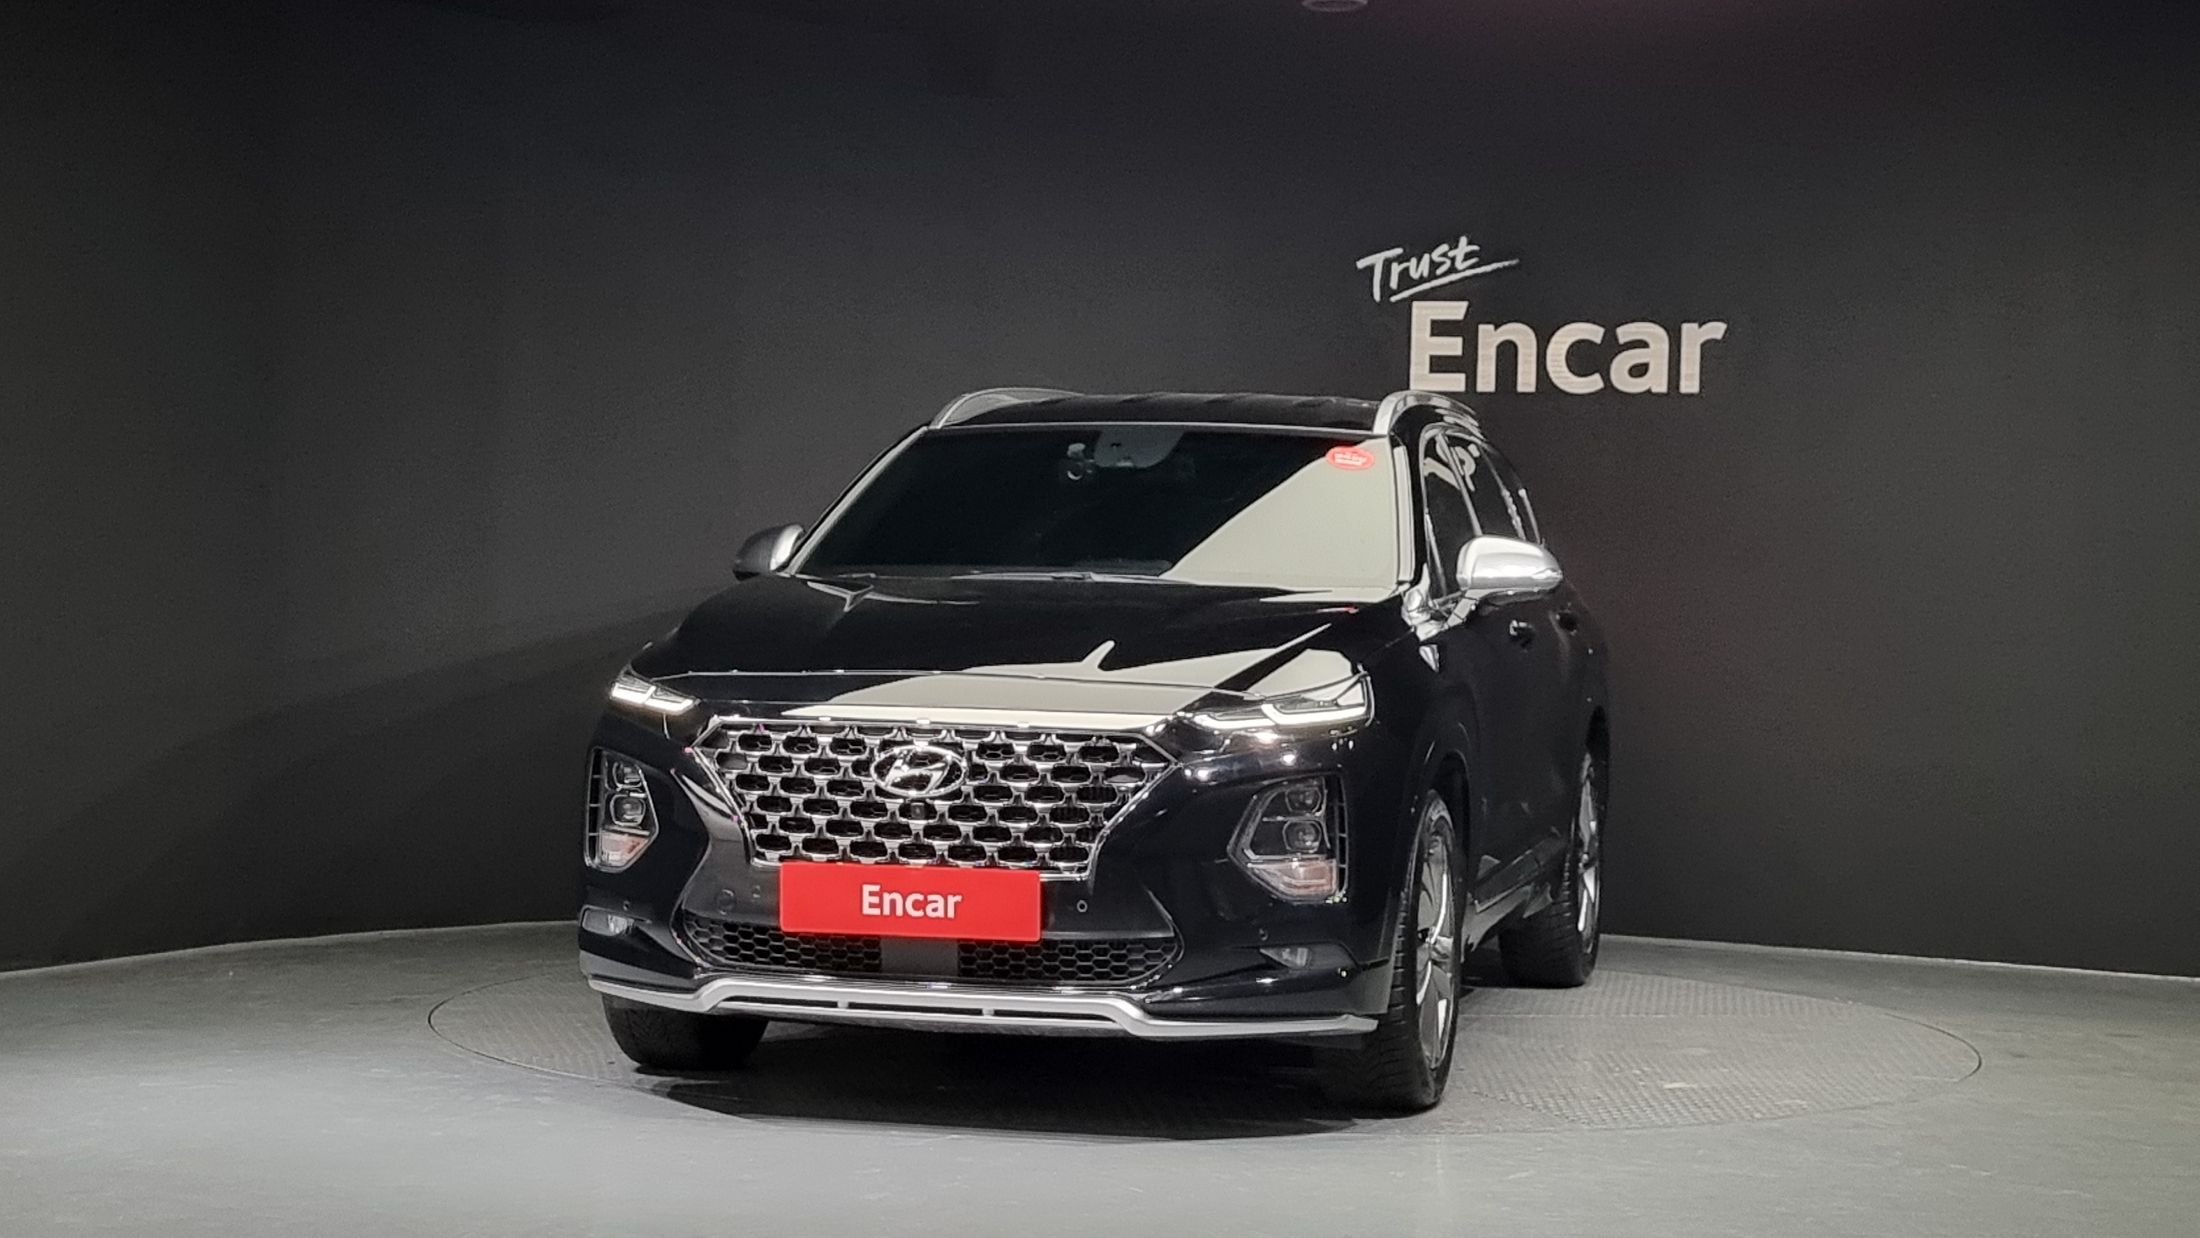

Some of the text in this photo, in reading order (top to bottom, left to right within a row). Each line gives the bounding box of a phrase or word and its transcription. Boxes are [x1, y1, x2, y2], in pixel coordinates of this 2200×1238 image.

[1356, 235, 1480, 303] Trust
[1409, 300, 1728, 395] Encar
[861, 883, 963, 919] Encar
